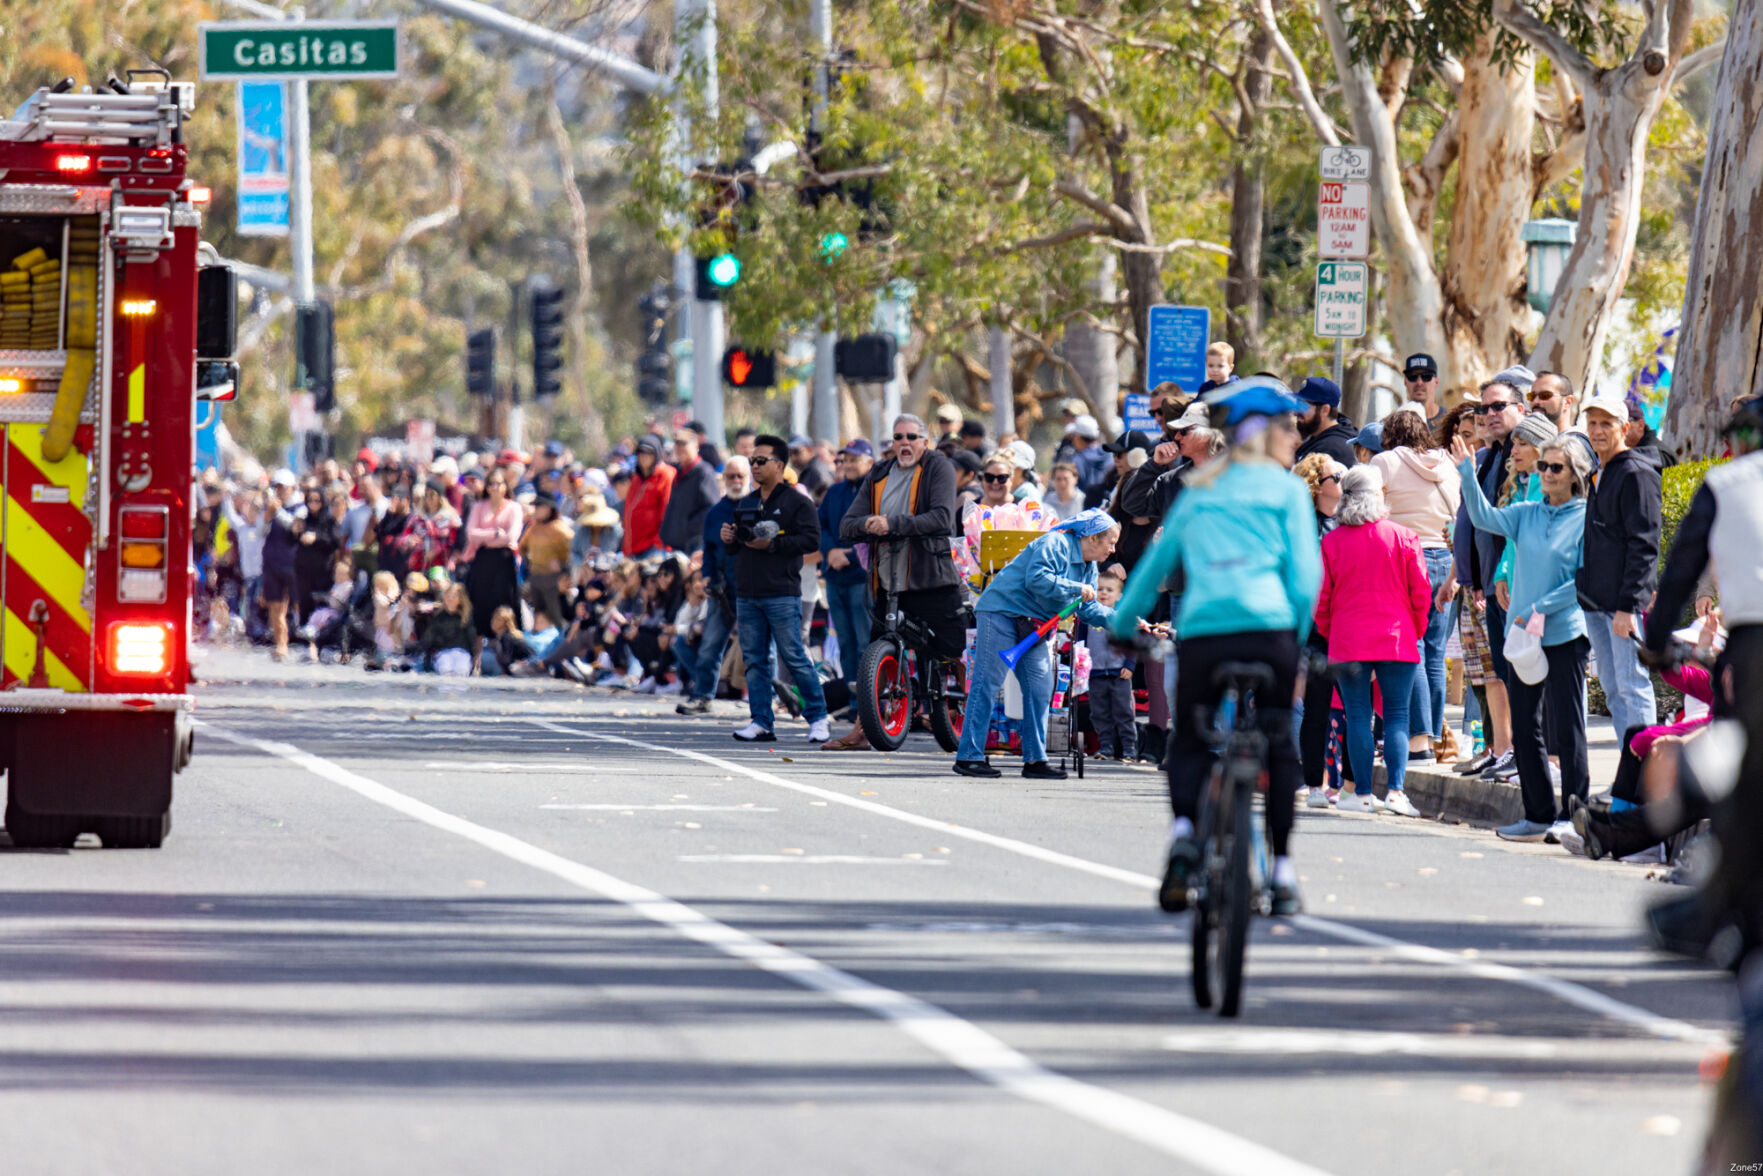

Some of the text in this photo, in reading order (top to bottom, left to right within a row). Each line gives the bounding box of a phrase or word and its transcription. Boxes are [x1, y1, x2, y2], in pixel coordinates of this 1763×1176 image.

[233, 36, 368, 66] Casitas
[1322, 185, 1341, 202] NO
[1321, 206, 1366, 221] PARKING
[1330, 222, 1356, 233] 12AM
[1321, 265, 1361, 282] 4 HOUR
[1320, 290, 1363, 304] PARKING
